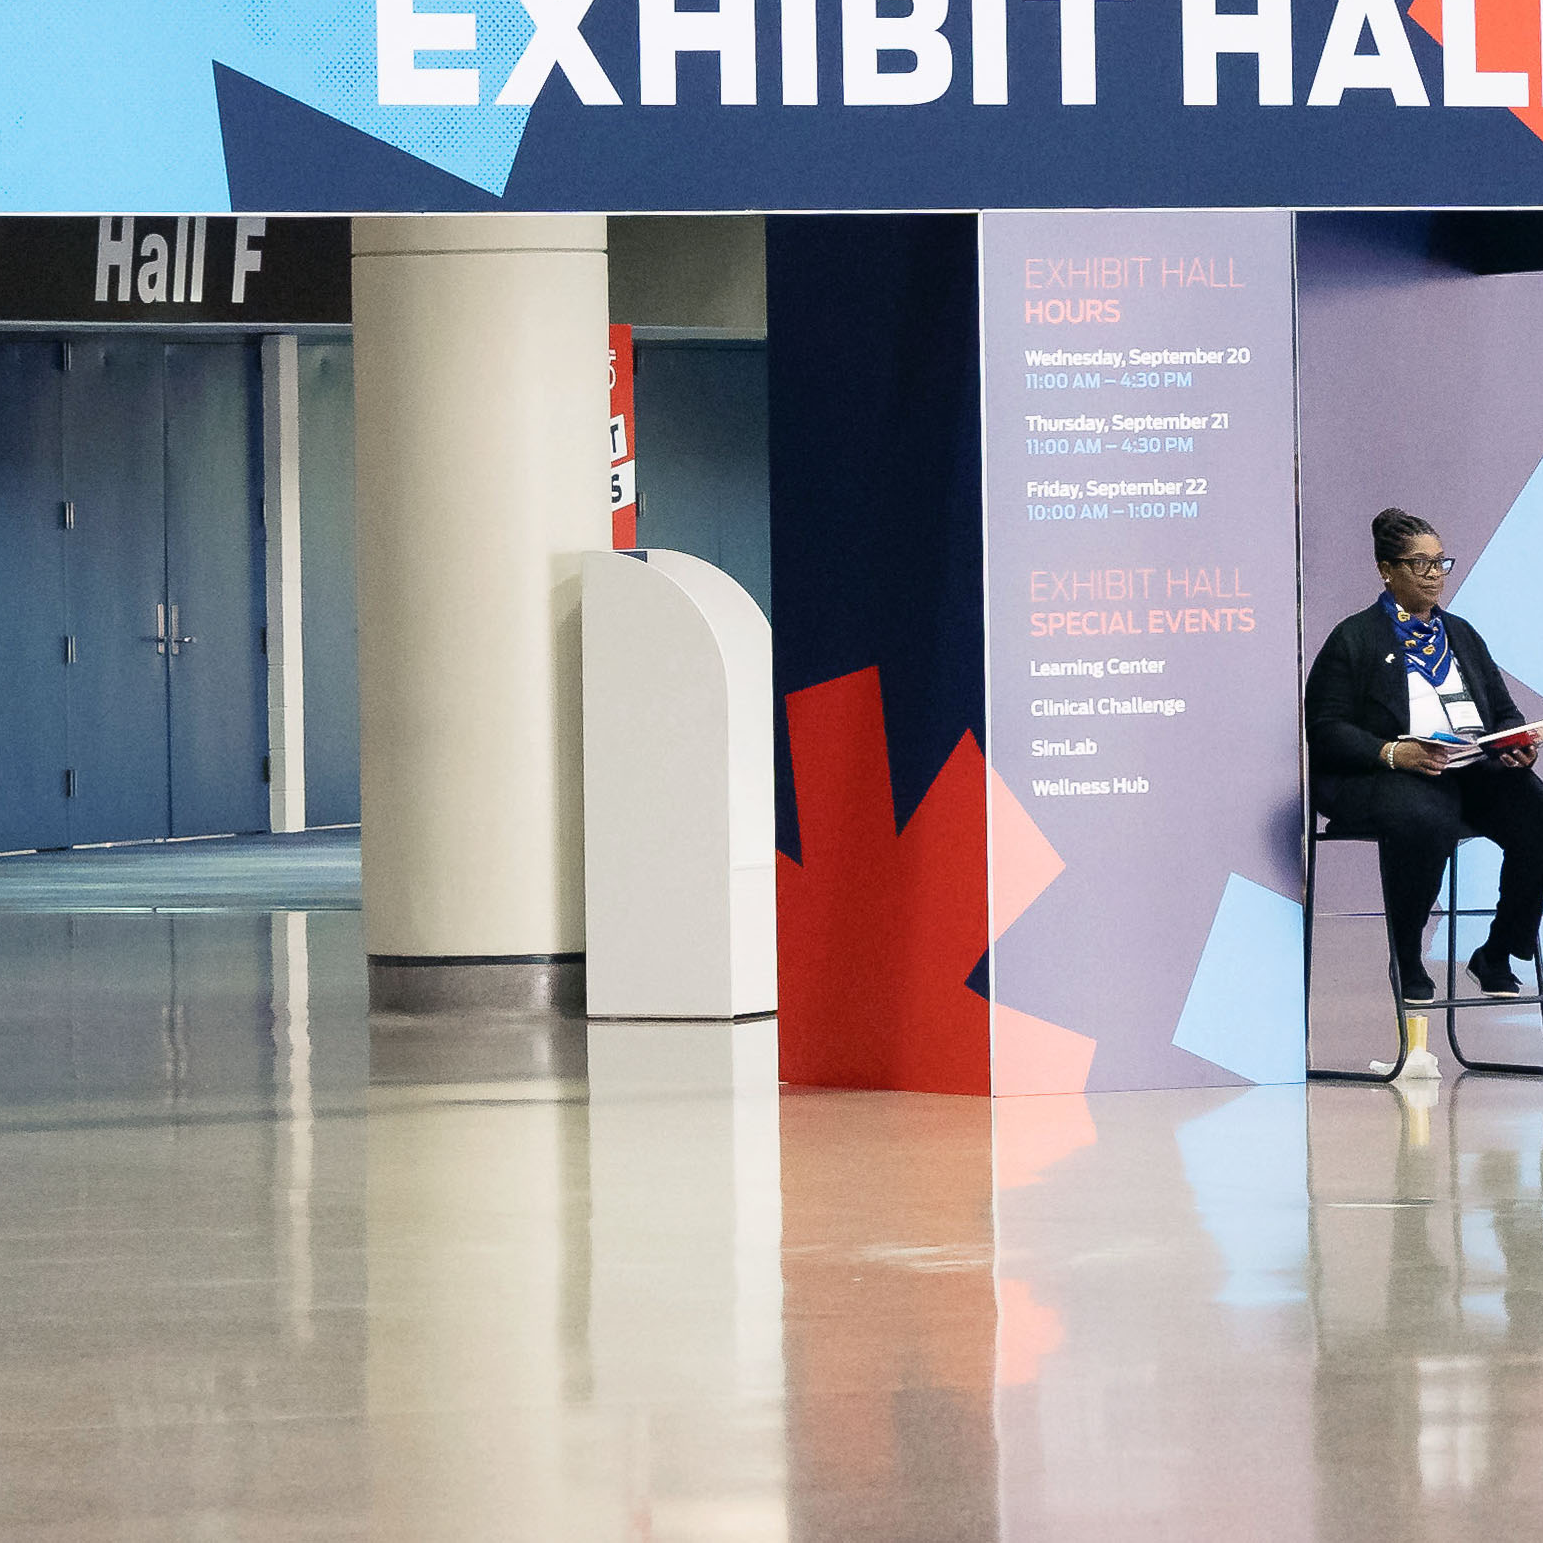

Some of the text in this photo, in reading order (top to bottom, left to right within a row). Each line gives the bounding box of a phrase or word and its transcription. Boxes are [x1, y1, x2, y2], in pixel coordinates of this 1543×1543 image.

[95, 216, 266, 303] Hall F
[1025, 256, 1246, 289] EXHIBIT HALL
[1025, 299, 1121, 324] HOURS
[1025, 347, 1251, 368] Wednesday, September 20
[1025, 373, 1068, 389] 11:00
[1072, 373, 1100, 388] AM
[1120, 372, 1159, 388] 4:30
[1164, 372, 1193, 387] PM
[1025, 413, 1229, 434] Thursday, September 21
[1026, 438, 1069, 454] 11:00
[1073, 438, 1101, 454] AM
[1121, 437, 1160, 453] 4:30
[1165, 437, 1194, 452] PM
[1027, 478, 1207, 499] Friday, September 22
[1027, 504, 1076, 521] 10:00
[1080, 504, 1108, 519] AM
[1128, 503, 1165, 518] 1:00
[1169, 502, 1198, 518] PM
[1030, 567, 1251, 602] EXHIBIT HALL
[1030, 608, 1256, 637] SPECIAL EVENTS
[1030, 658, 1165, 678] Learning Center
[1031, 697, 1186, 716] Clinical Challenge
[1032, 738, 1098, 757] SimLab
[1032, 777, 1149, 797] Wellness Hub
